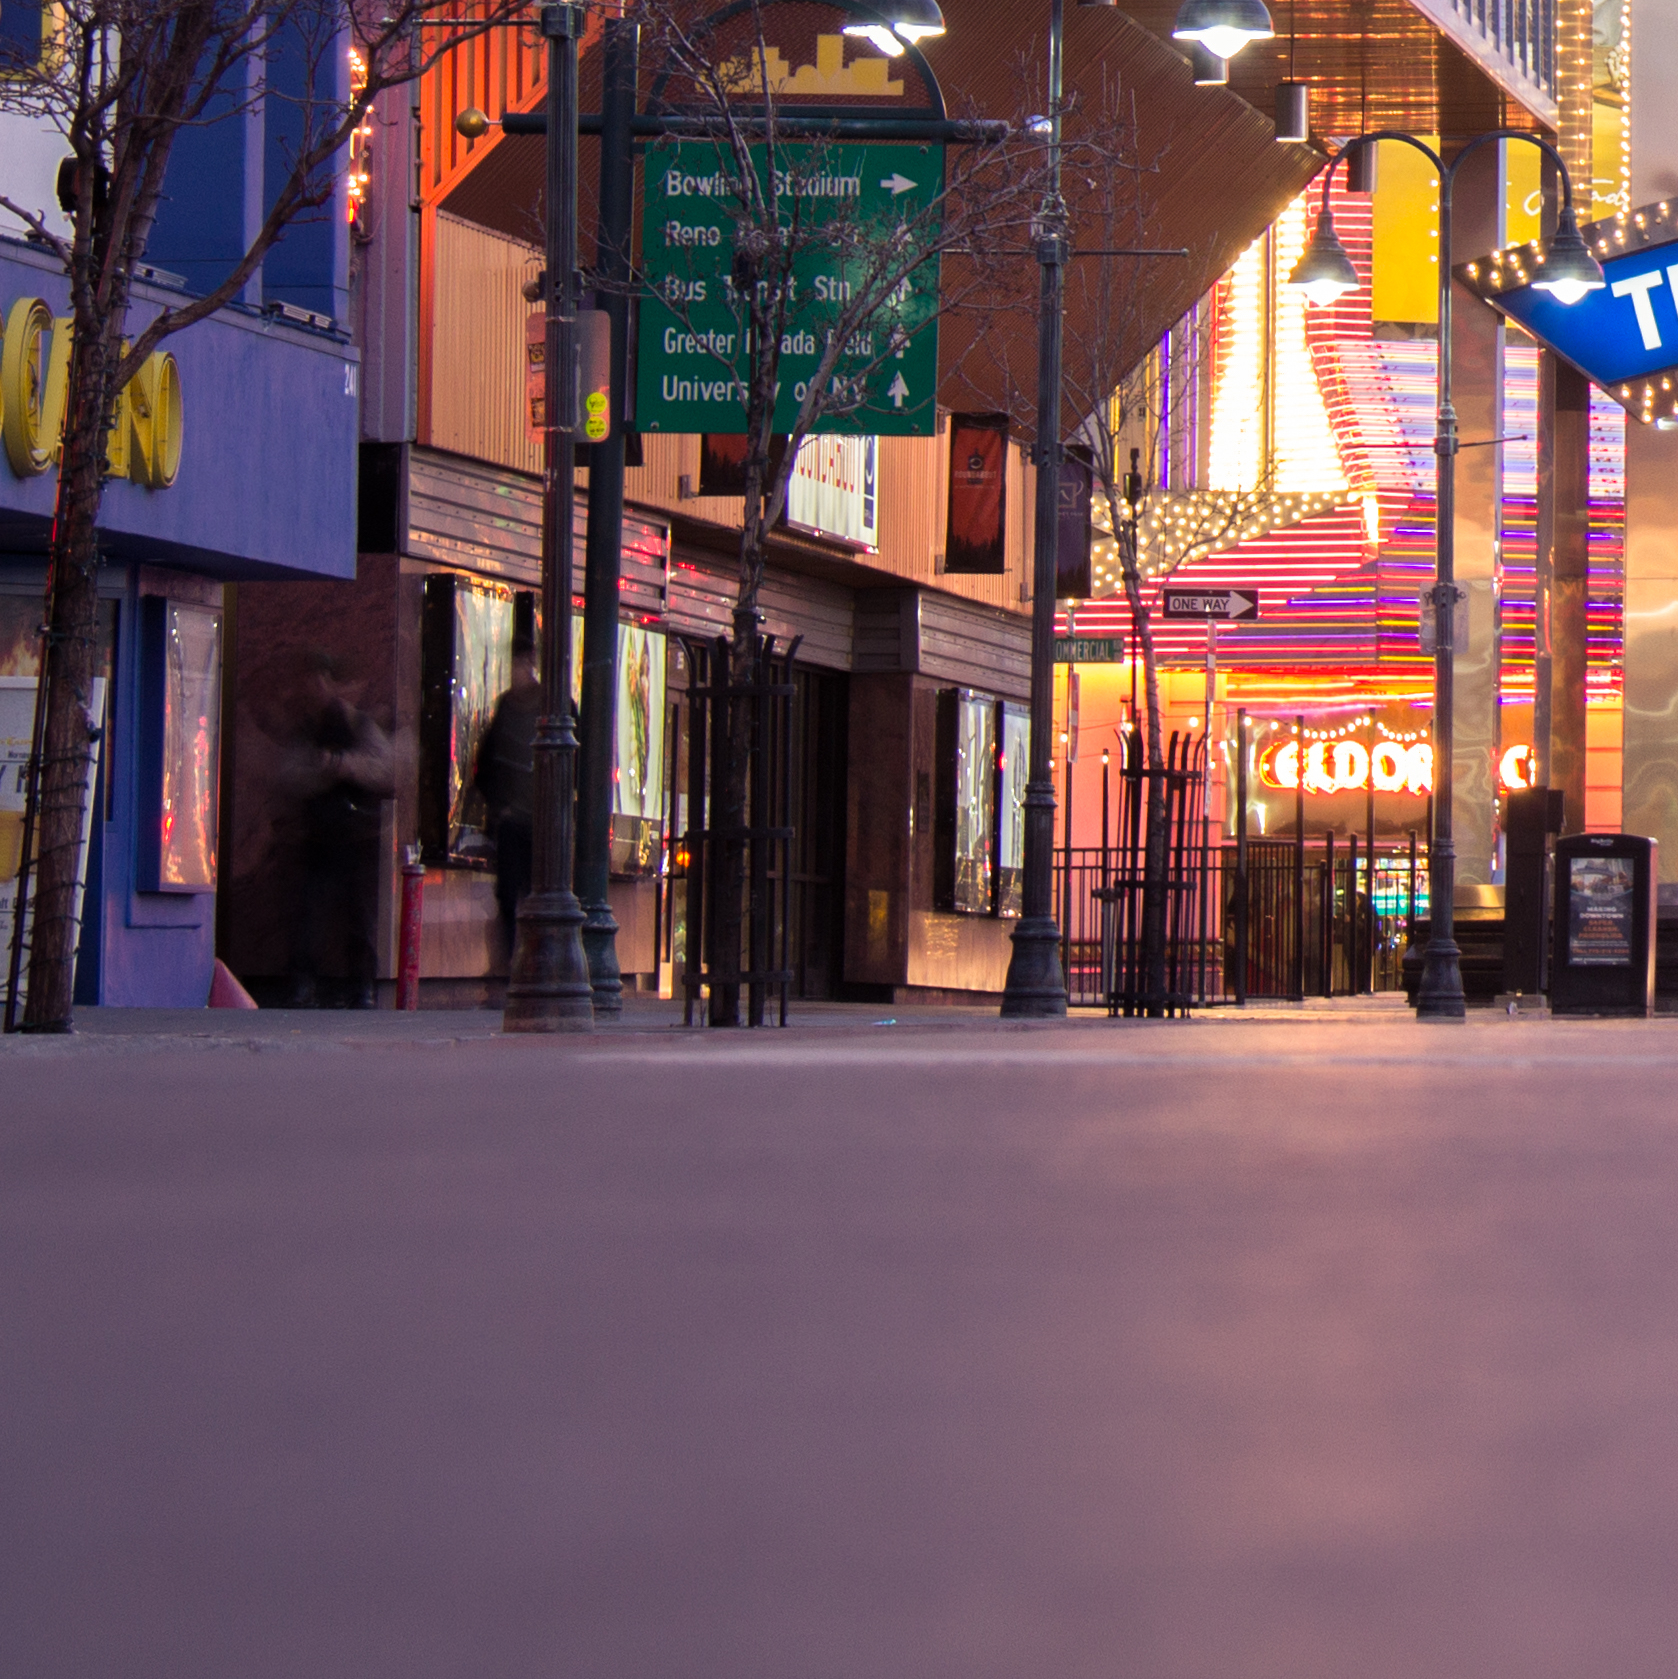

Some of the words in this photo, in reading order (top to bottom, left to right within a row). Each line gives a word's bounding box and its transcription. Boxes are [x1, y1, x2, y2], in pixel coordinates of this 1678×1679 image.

[665, 220, 720, 247] Reno
[664, 274, 707, 301] Bus
[664, 328, 735, 354] Greater
[1172, 598, 1197, 611] ONE
[1203, 598, 1230, 611] WAY
[1055, 640, 1111, 660] OMMERCIAL
